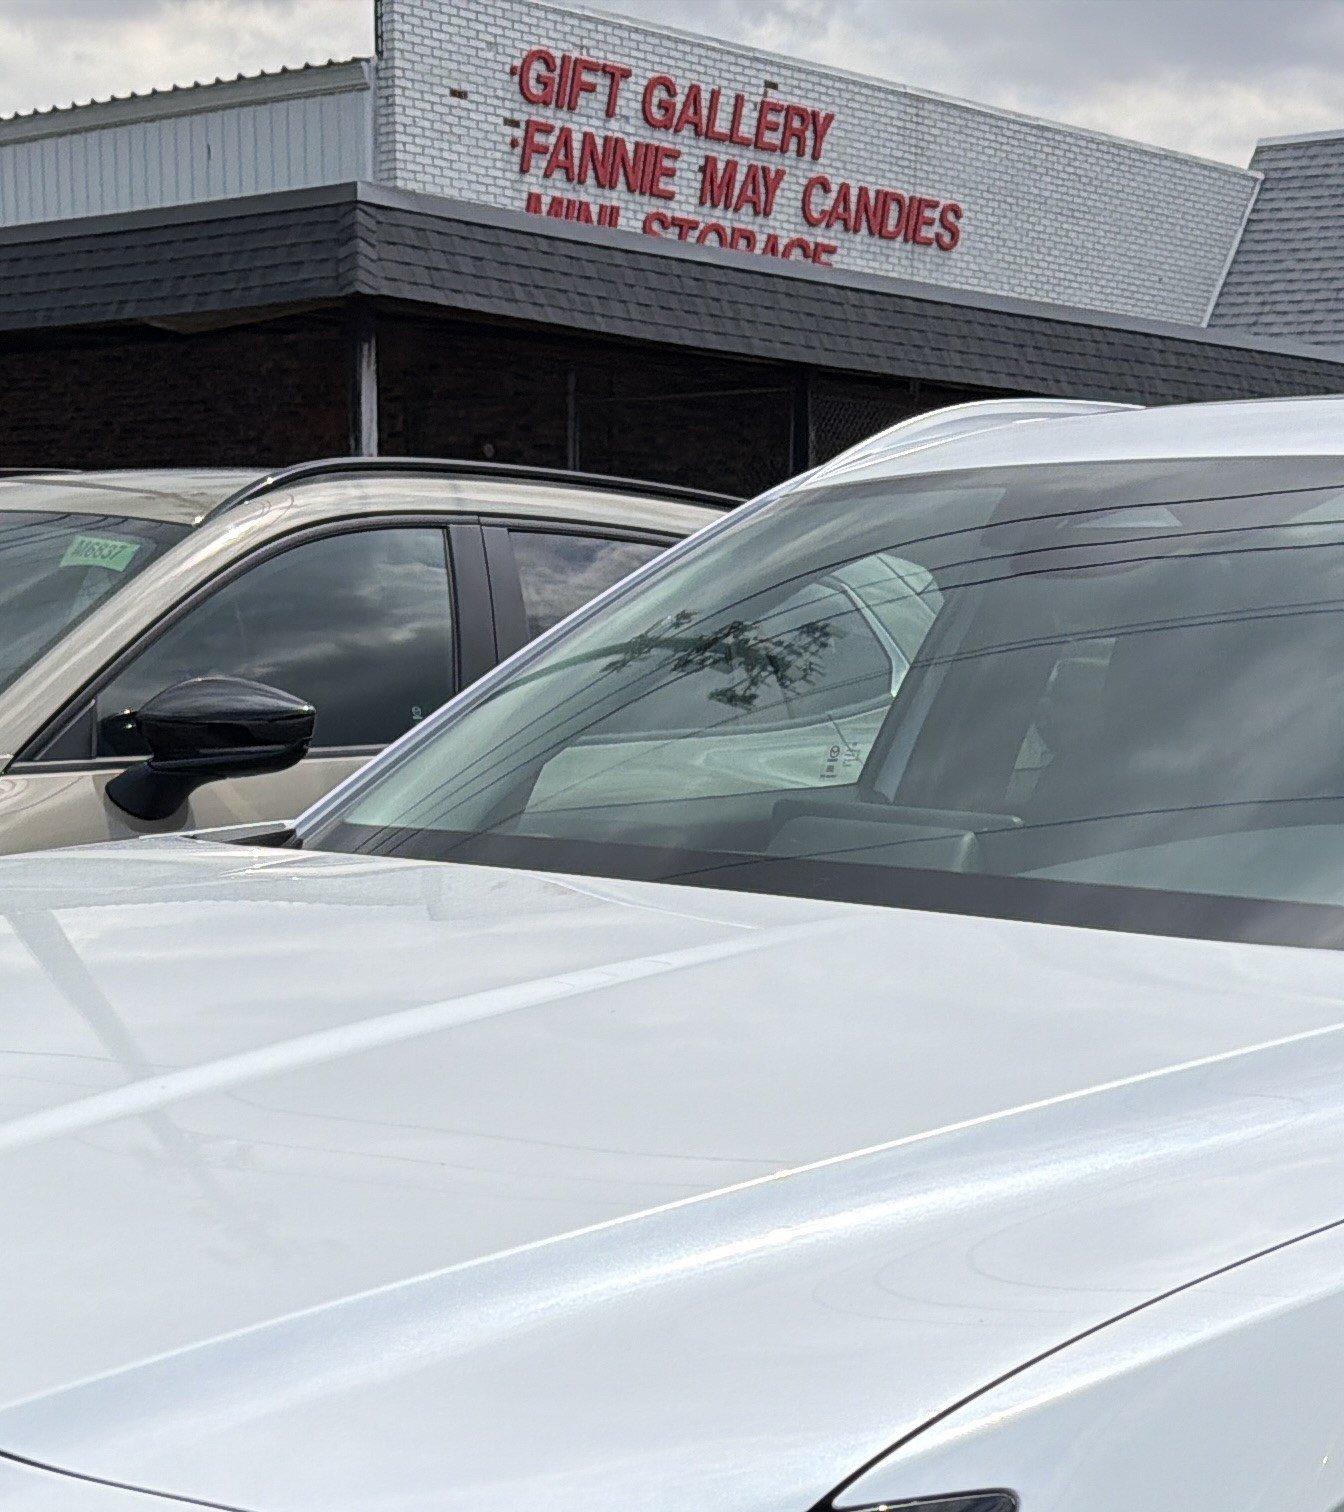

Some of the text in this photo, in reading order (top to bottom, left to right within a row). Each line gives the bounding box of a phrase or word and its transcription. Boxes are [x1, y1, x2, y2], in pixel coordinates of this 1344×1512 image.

[519, 48, 835, 161] GIFT GALLERY
[519, 119, 682, 200] FANNIE
[700, 154, 787, 218] MAY
[802, 175, 964, 252] CANDIES
